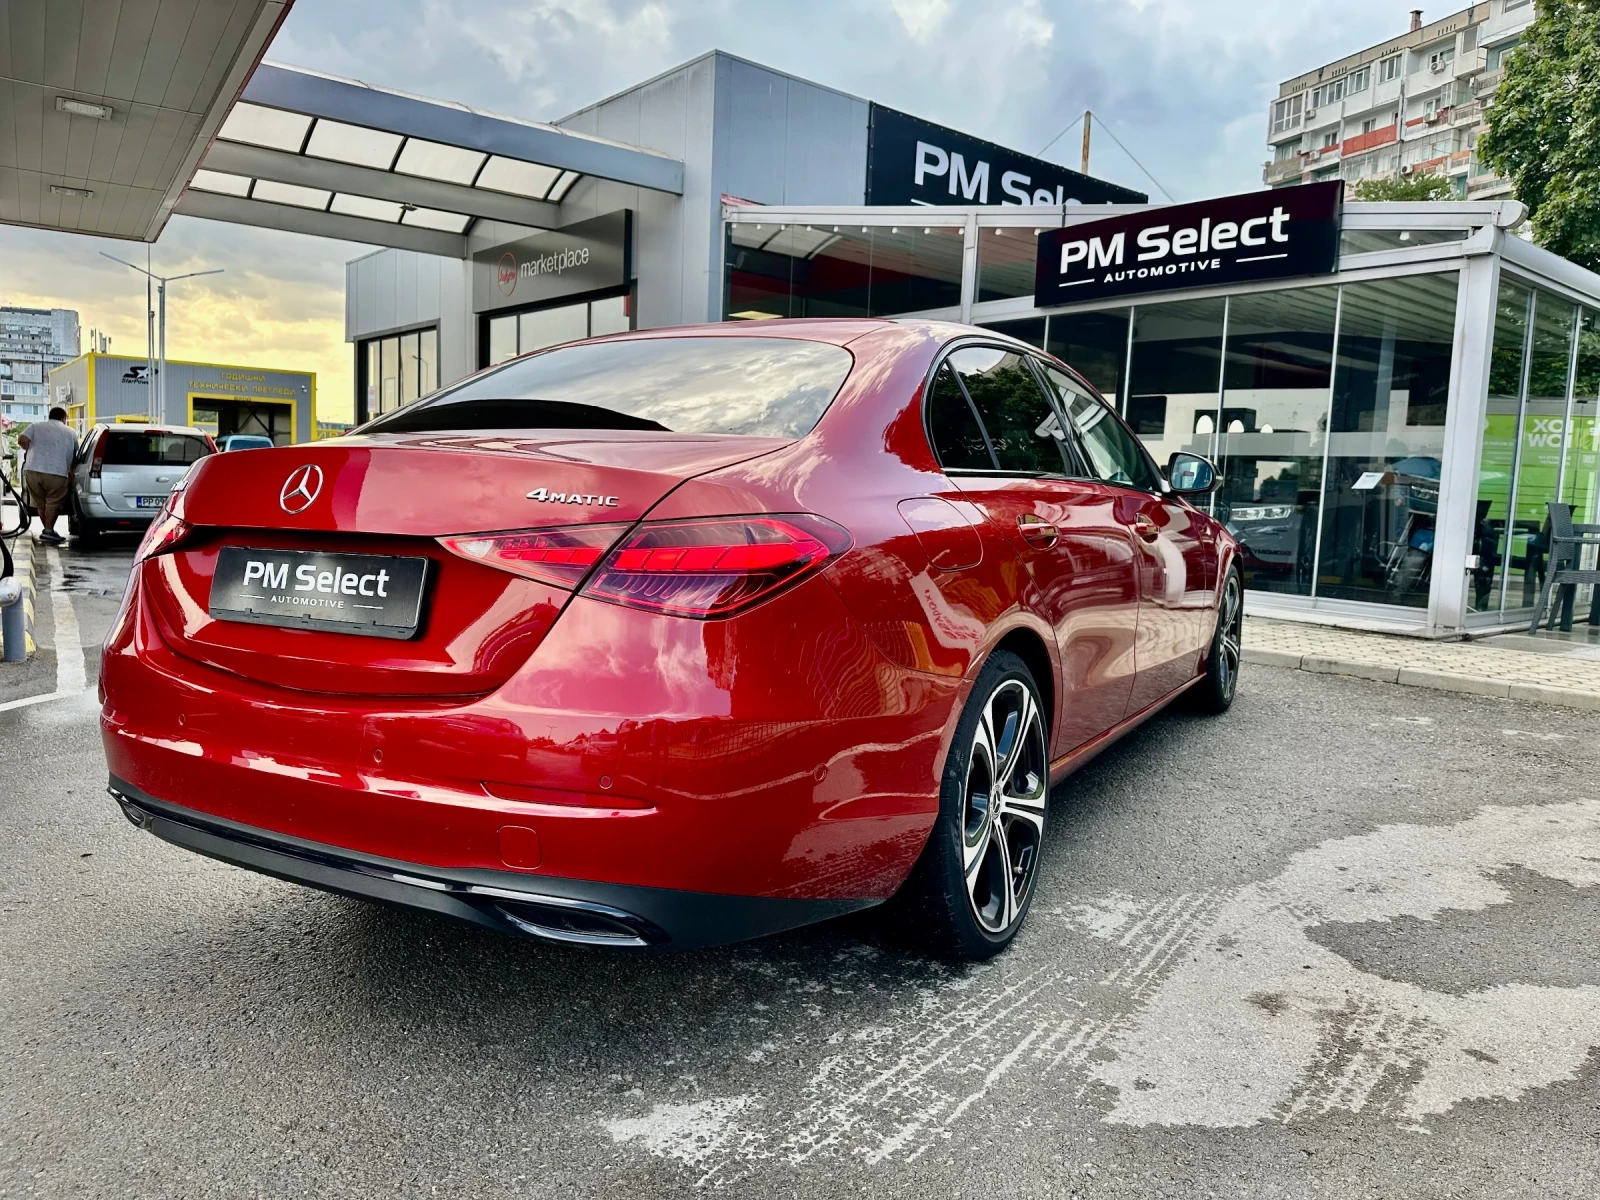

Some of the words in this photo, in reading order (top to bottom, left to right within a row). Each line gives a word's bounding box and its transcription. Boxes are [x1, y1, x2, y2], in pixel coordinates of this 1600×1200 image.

[914, 140, 990, 204] PM
[1060, 232, 1125, 274] PM
[1137, 206, 1290, 261] Select
[520, 248, 589, 278] marketplace
[1104, 258, 1221, 283] AUTOMOTIVE
[526, 487, 619, 507] 4MATIC
[243, 561, 289, 589] PM
[294, 564, 390, 598] Select
[270, 595, 345, 609] AUTOMOTIVE
